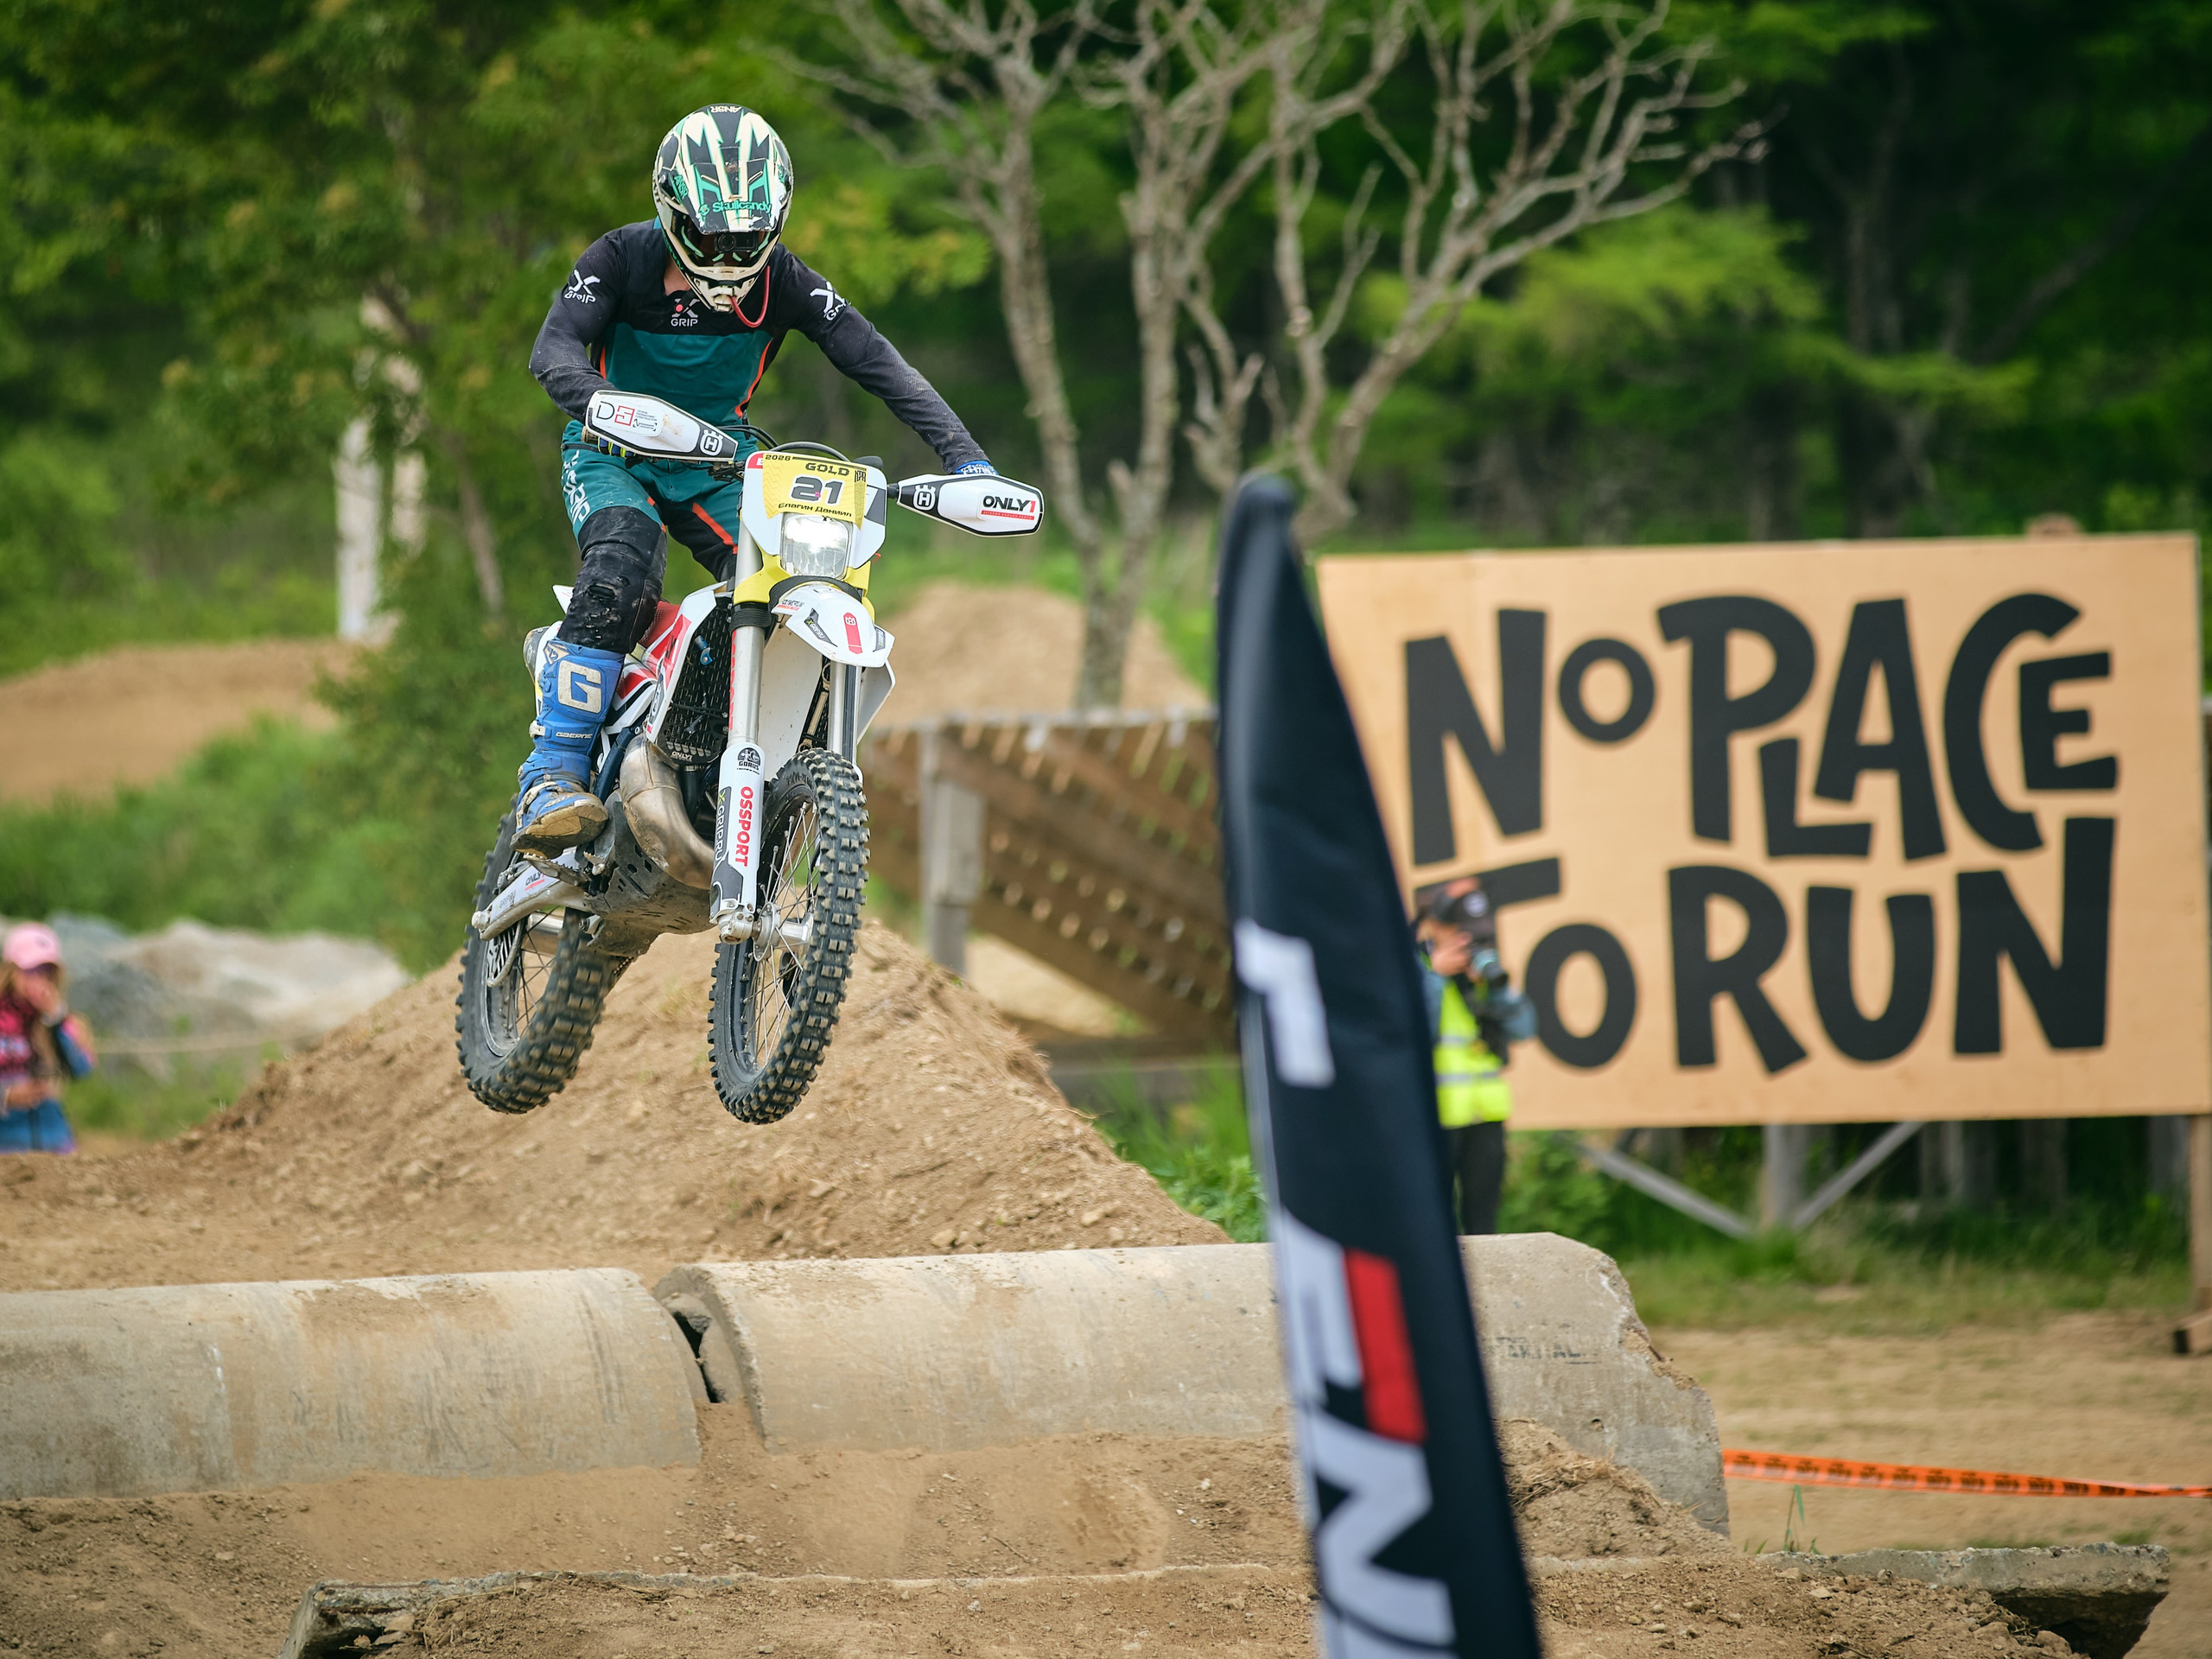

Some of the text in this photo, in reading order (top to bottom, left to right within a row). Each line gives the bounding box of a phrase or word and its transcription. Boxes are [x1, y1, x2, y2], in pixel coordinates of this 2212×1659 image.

[674, 175, 689, 200] ANSR
[712, 199, 772, 213] Skullcandy
[564, 290, 596, 303] GRIP
[671, 318, 698, 327] GRIP
[805, 462, 850, 476] GOLD
[791, 476, 843, 505] 21
[778, 502, 852, 518] Елагин Даниил
[982, 495, 1036, 513] ONLY1
[558, 660, 602, 714] G
[1405, 592, 2118, 864] NO PLACE
[739, 761, 759, 771] GORUS
[734, 786, 753, 868] OSSPORT
[1667, 817, 2116, 1074] RUN
